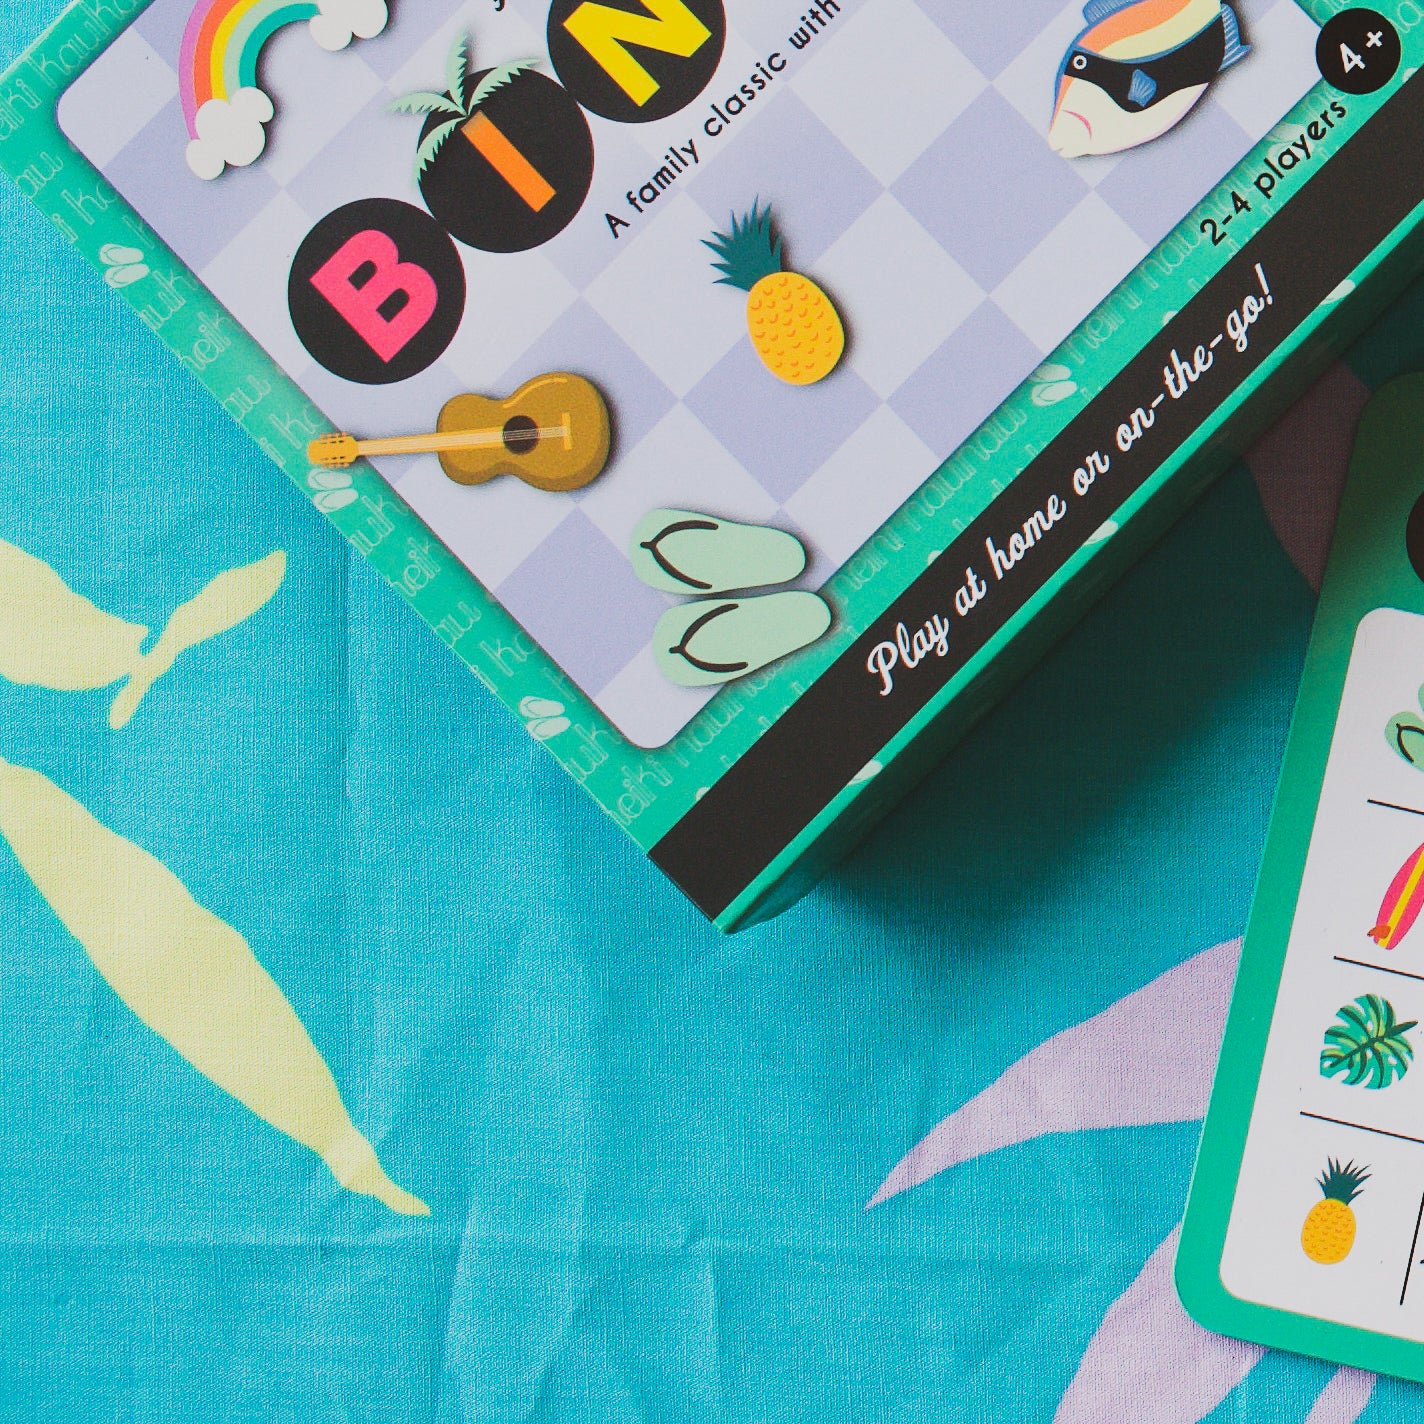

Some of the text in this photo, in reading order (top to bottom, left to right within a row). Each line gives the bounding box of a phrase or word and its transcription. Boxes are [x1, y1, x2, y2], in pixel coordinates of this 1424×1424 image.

[1339, 30, 1383, 73] 4+
[605, 213, 631, 239] A
[626, 138, 699, 214] family
[704, 52, 787, 137] classic
[1199, 190, 1252, 247] 2-4
[1253, 101, 1347, 200] players
[867, 614, 949, 696] Play
[955, 566, 987, 617] at
[985, 494, 1067, 580] home
[1073, 450, 1110, 496] or
[1116, 262, 1273, 452] on-the-go!
